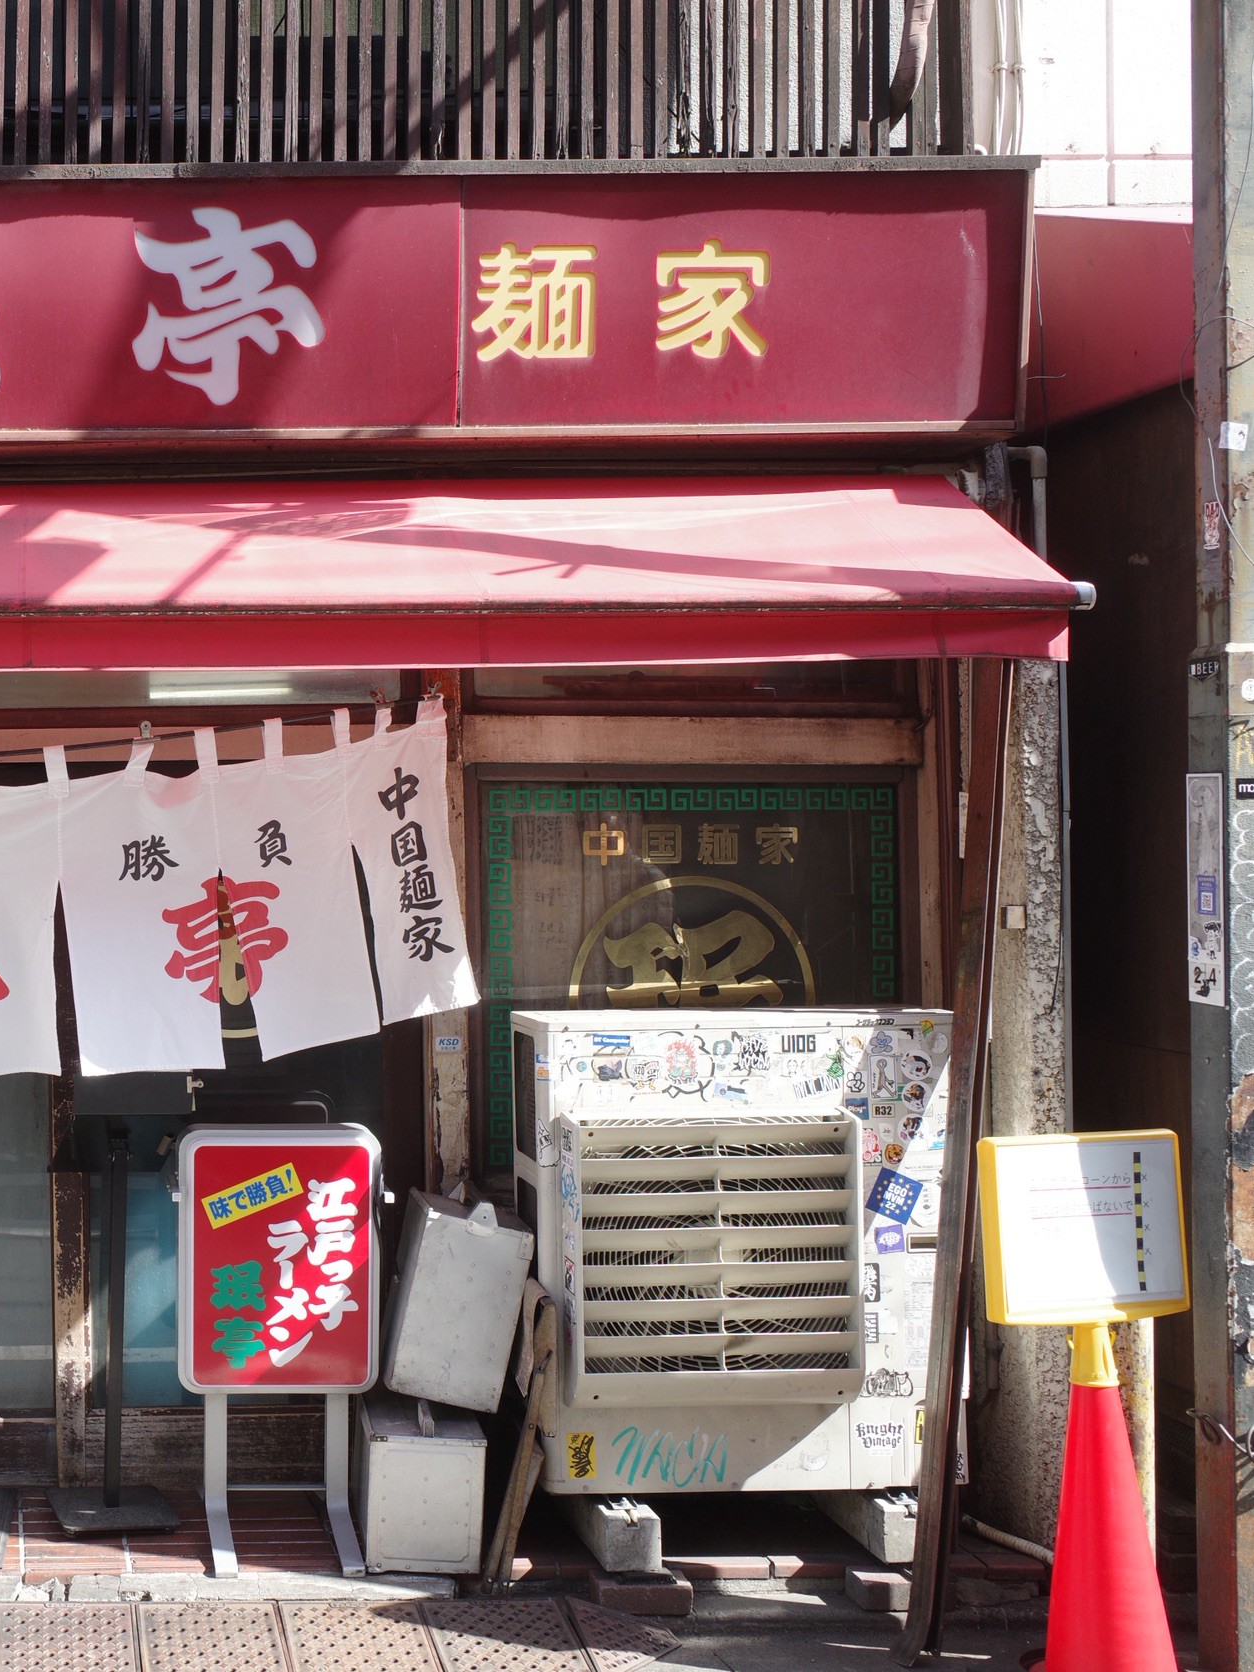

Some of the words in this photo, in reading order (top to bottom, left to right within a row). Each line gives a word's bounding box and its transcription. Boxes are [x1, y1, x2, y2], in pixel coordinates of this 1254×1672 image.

[1197, 662, 1220, 675] BEER
[582, 822, 800, 866] 中国麺家
[438, 1038, 460, 1046] KSD
[875, 1106, 892, 1115] R32
[209, 1168, 296, 1221] 味で勝負！
[887, 1183, 907, 1198] EGO
[884, 1200, 897, 1211] 22
[306, 1177, 359, 1331] 江戸っ子
[266, 1220, 313, 1367] ラーメン
